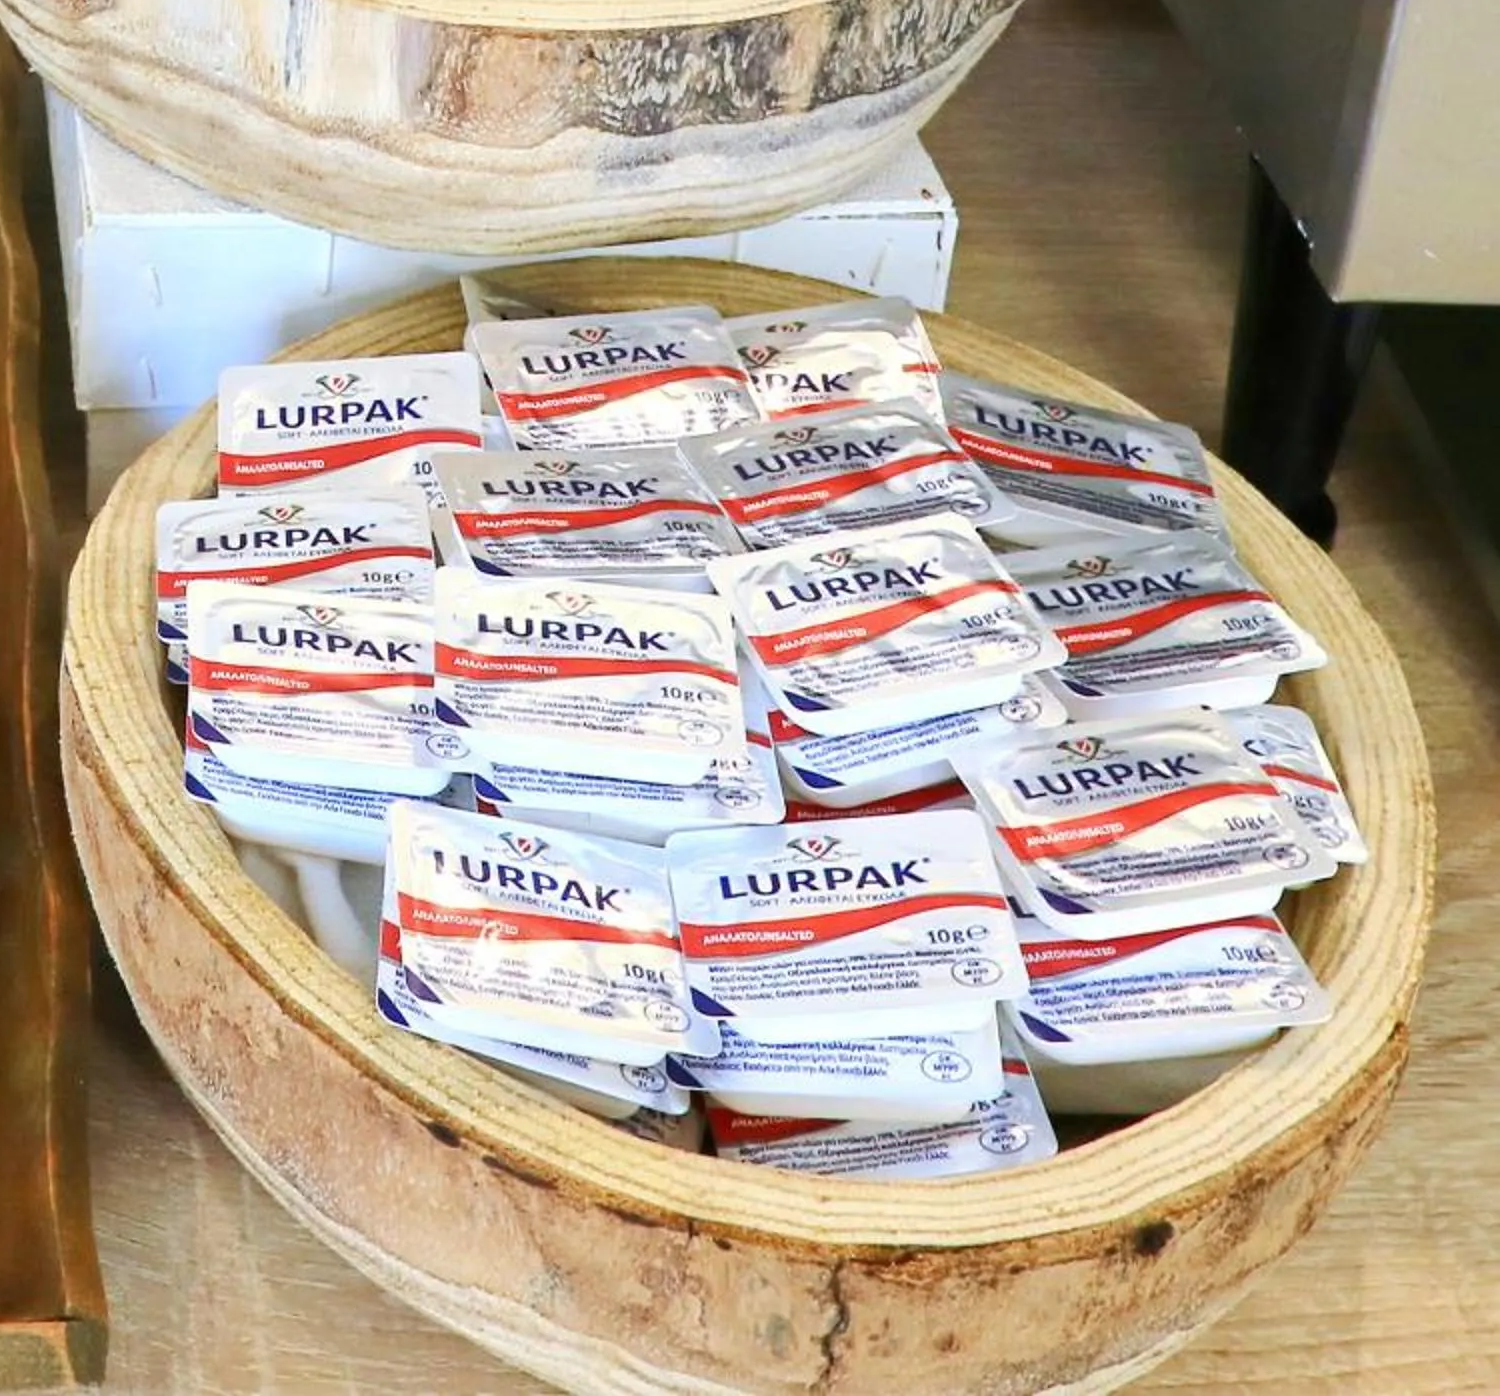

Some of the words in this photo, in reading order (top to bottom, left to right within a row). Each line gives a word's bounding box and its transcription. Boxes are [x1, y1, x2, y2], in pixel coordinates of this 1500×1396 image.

[521, 342, 686, 375] LURPAK
[750, 373, 851, 393] PAK
[256, 396, 422, 430] LURPAK
[974, 405, 1148, 463] LURPAK
[413, 461, 433, 476] 10
[732, 438, 898, 482] LURPAK
[482, 478, 658, 498] LURPAK
[196, 524, 371, 553] LURPAK
[362, 571, 394, 585] 10g
[765, 560, 942, 612] LURPAK
[1028, 570, 1200, 612] LURPAK
[232, 623, 417, 664] LURPAK
[477, 613, 669, 652] LURPAK
[408, 703, 436, 716] 10
[660, 685, 695, 703] 10g
[1013, 755, 1202, 801] LURPAK
[718, 858, 928, 901] LURPAK
[926, 927, 965, 945] 10g
